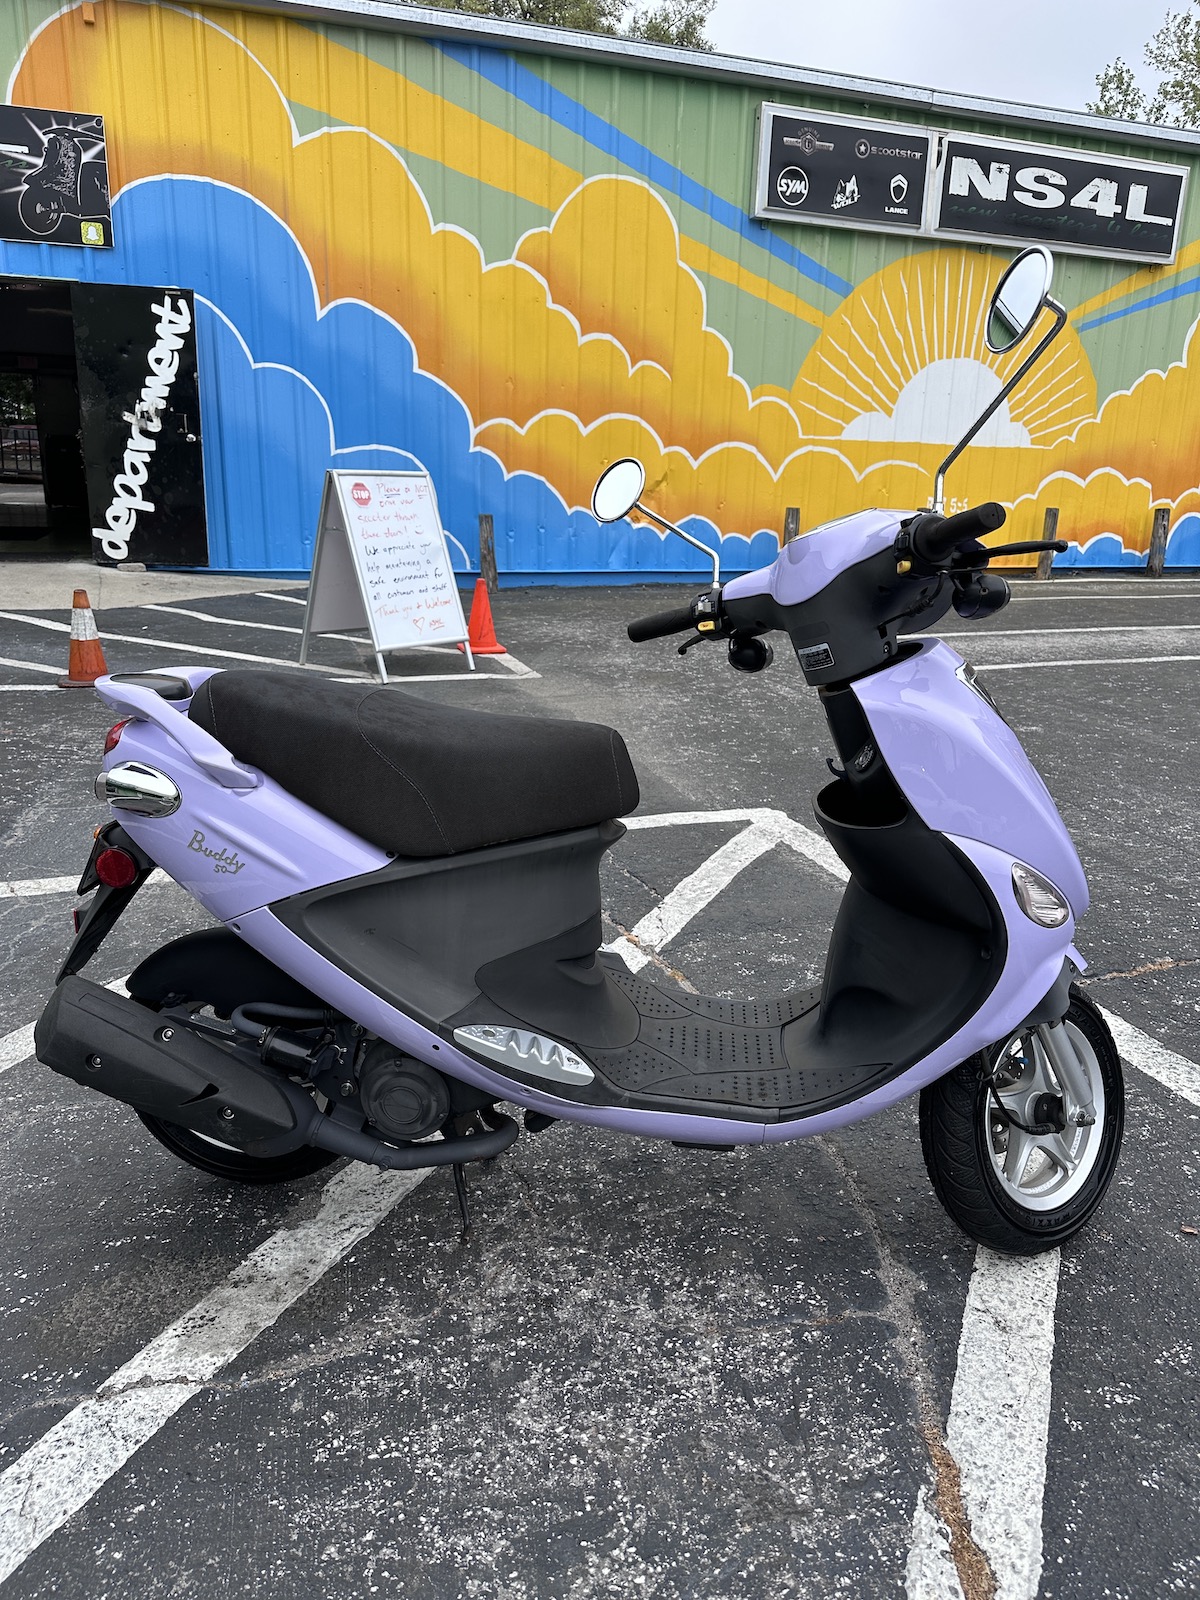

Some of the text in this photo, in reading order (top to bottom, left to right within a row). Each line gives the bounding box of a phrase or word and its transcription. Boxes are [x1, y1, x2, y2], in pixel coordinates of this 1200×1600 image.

[870, 146, 923, 160] scootstar
[778, 178, 807, 196] SYM
[949, 155, 1173, 227] NS4L
[884, 206, 909, 215] LANCE
[92, 295, 191, 560] department
[353, 489, 370, 499] STOP
[187, 829, 246, 875] Buddy
[213, 863, 228, 874] 50
